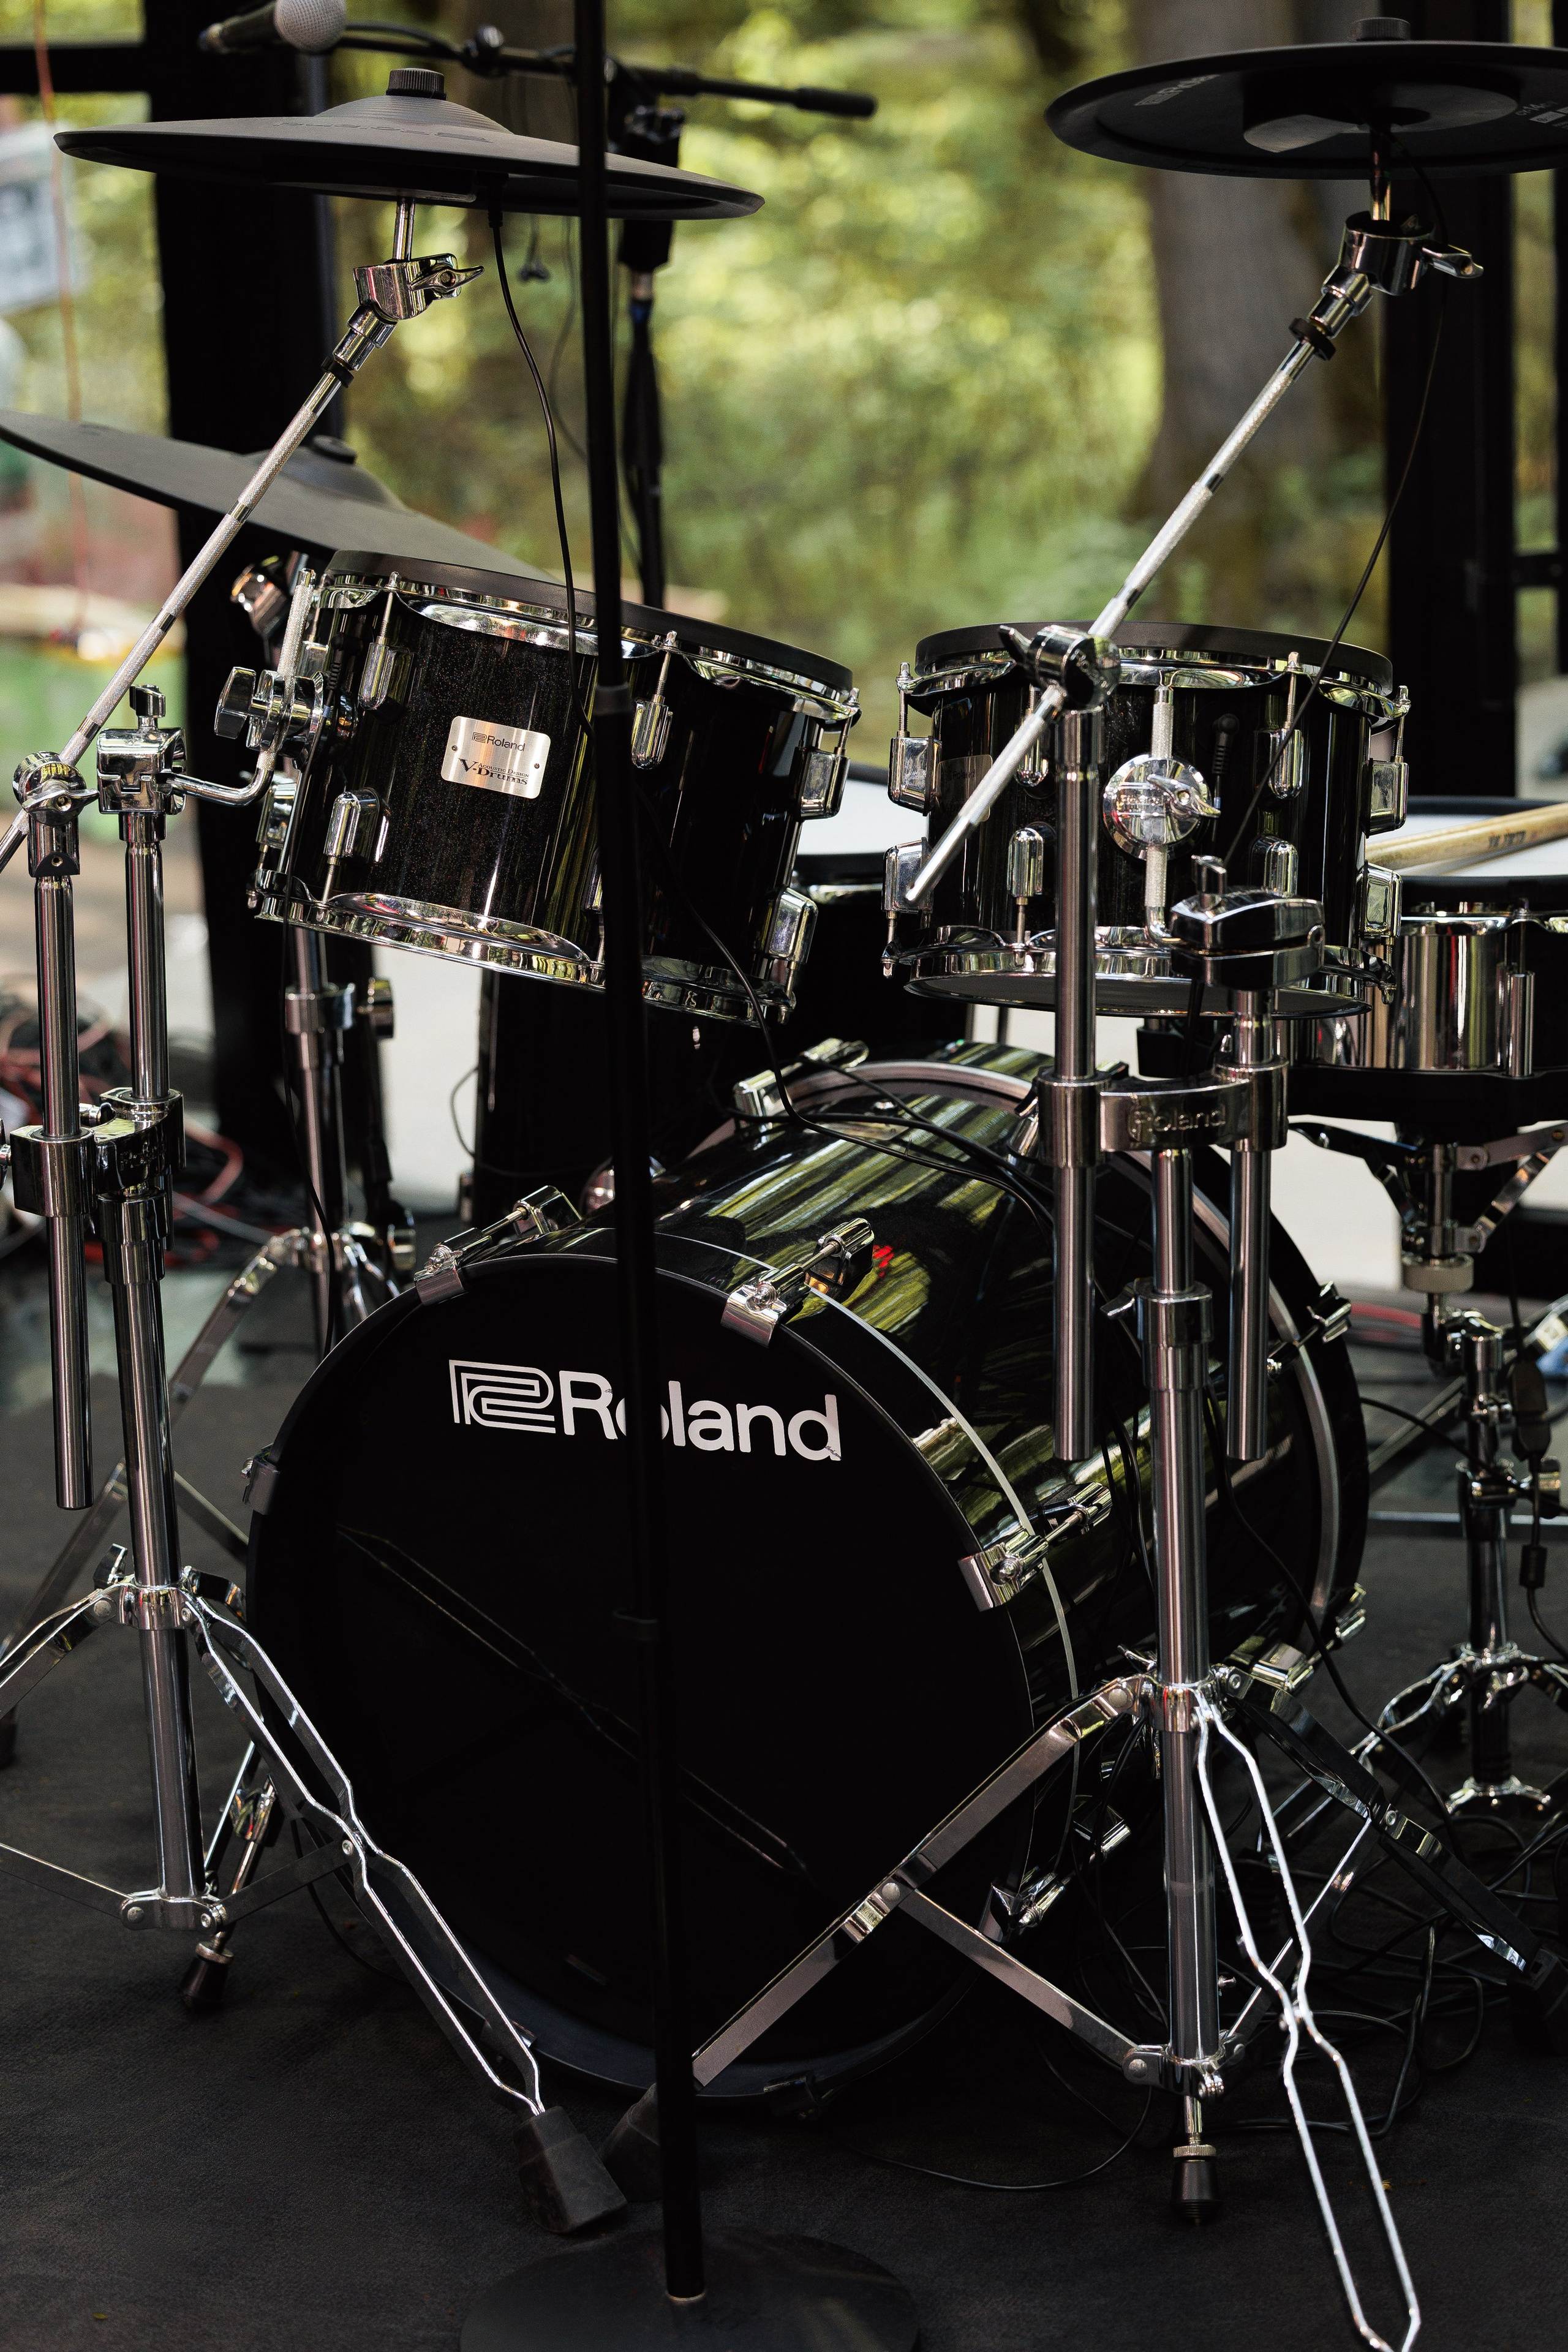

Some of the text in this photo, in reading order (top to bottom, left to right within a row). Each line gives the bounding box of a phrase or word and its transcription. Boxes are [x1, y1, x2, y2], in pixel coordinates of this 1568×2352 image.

[486, 735, 526, 752] Roland
[458, 758, 528, 785] V-Drums
[1129, 1104, 1226, 1138] Roland
